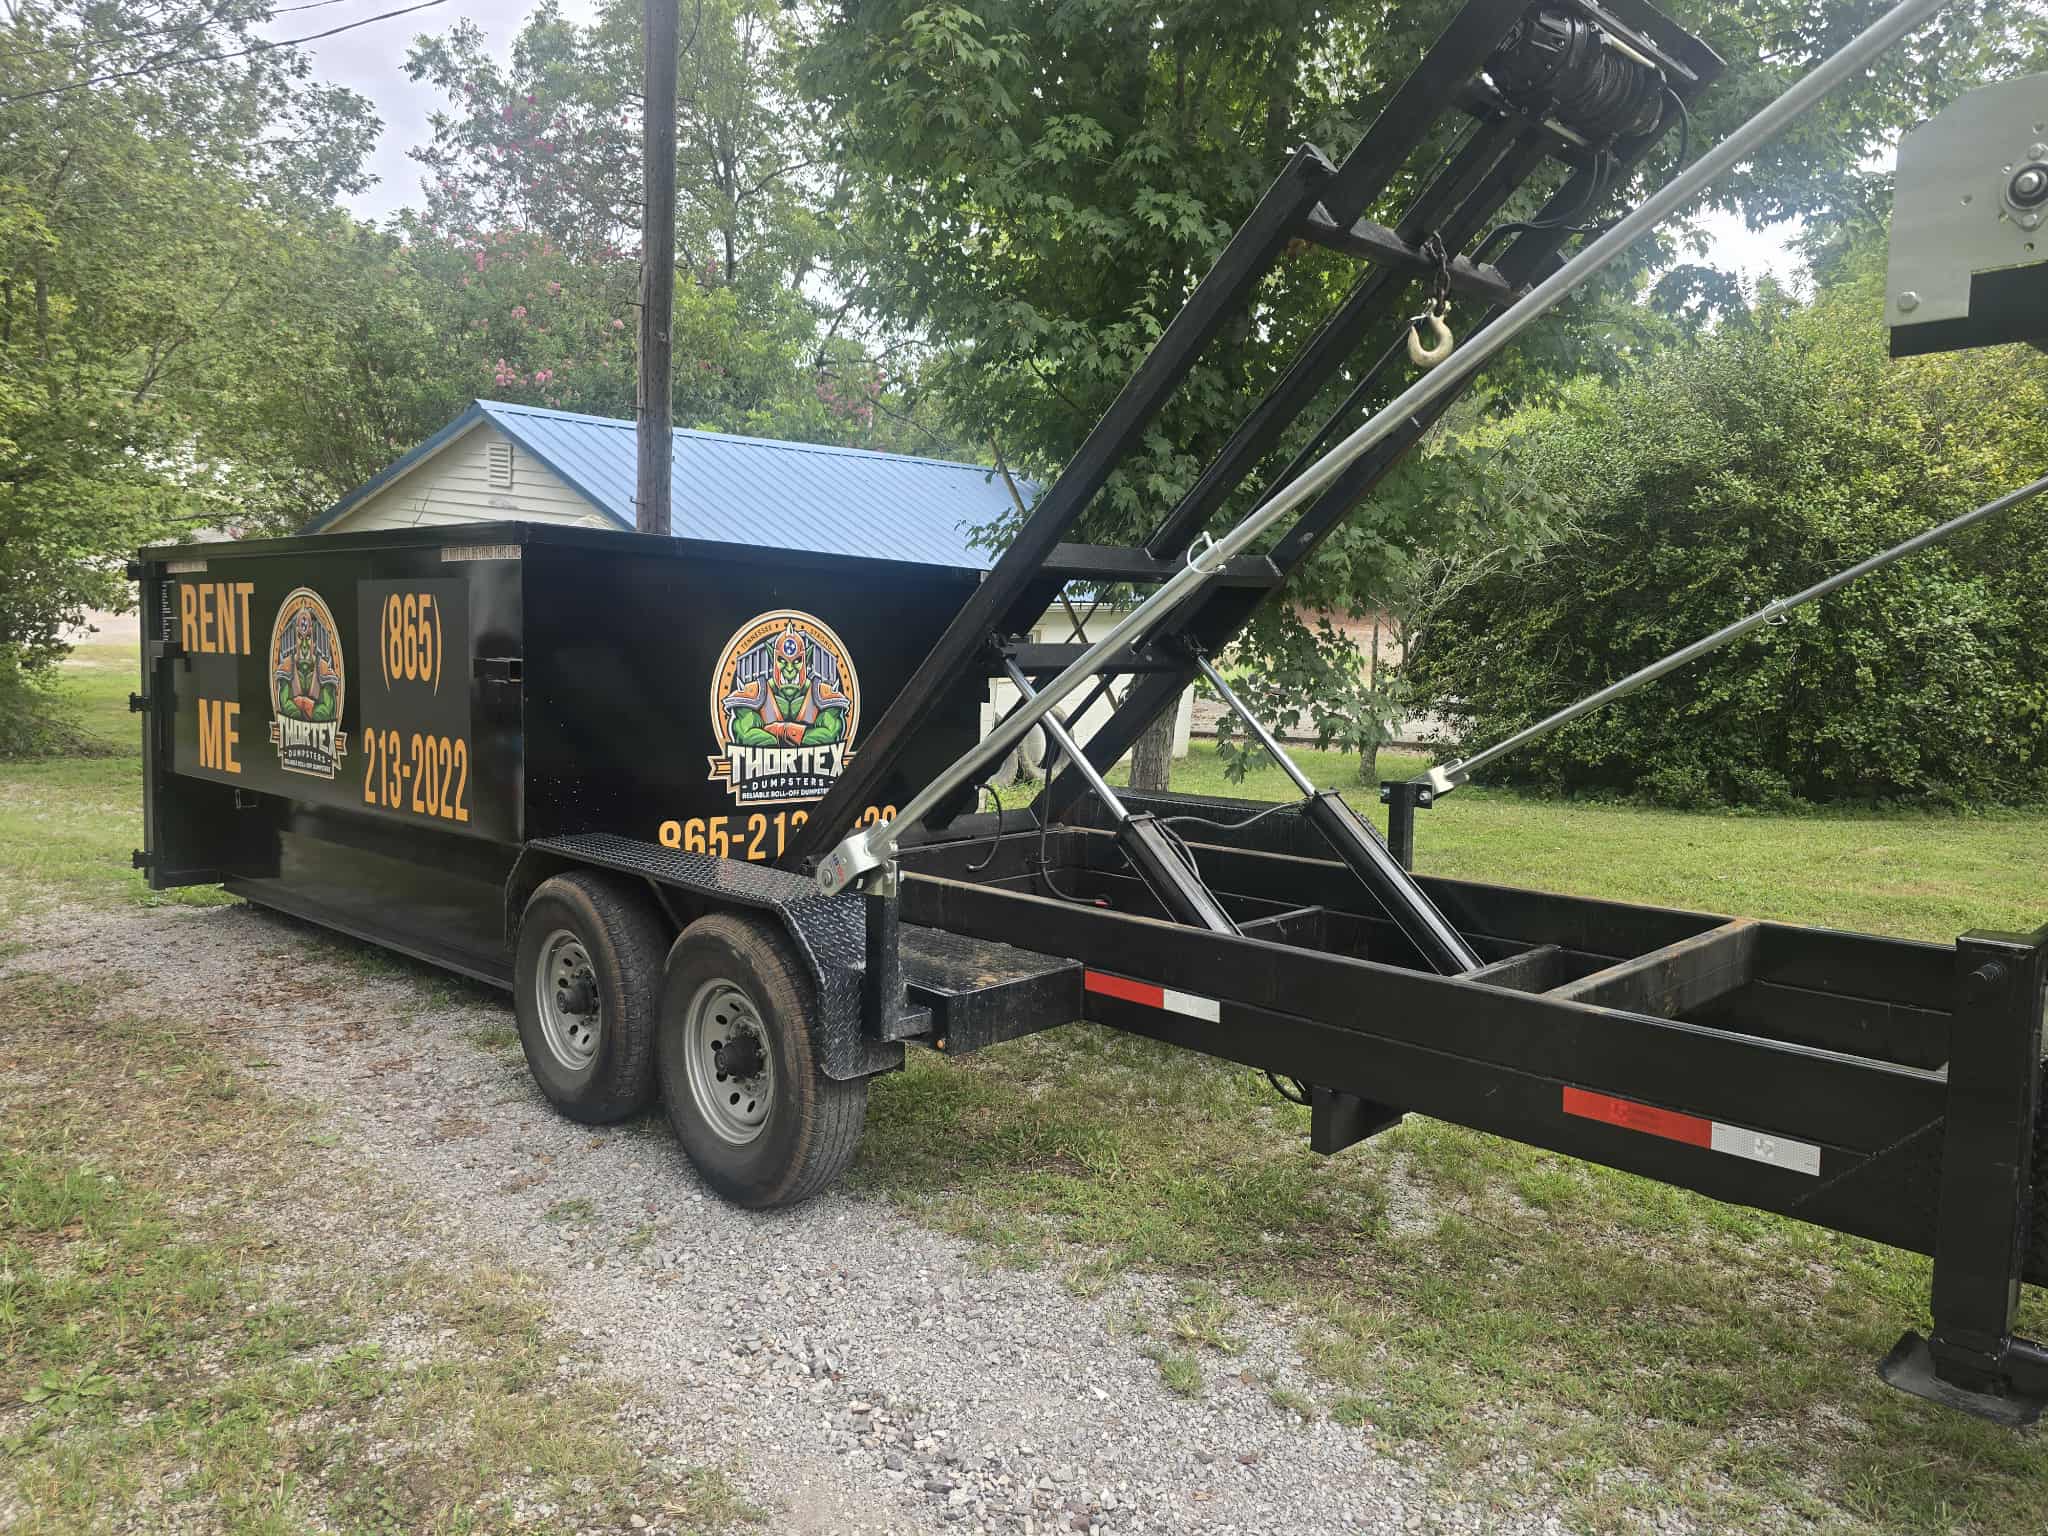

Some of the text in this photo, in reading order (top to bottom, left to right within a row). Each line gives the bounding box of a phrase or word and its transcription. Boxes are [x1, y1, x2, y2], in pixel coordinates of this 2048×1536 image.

[180, 583, 254, 655] RENT
[381, 593, 442, 696] (865)
[198, 699, 242, 774] ME
[277, 713, 337, 760] THORTEX
[288, 749, 326, 764] DUMPSTERS
[363, 727, 469, 822] 213-2022
[727, 742, 846, 784] THORTEX
[752, 777, 824, 790] DUMPSTERS
[742, 790, 770, 799] RELIABLE
